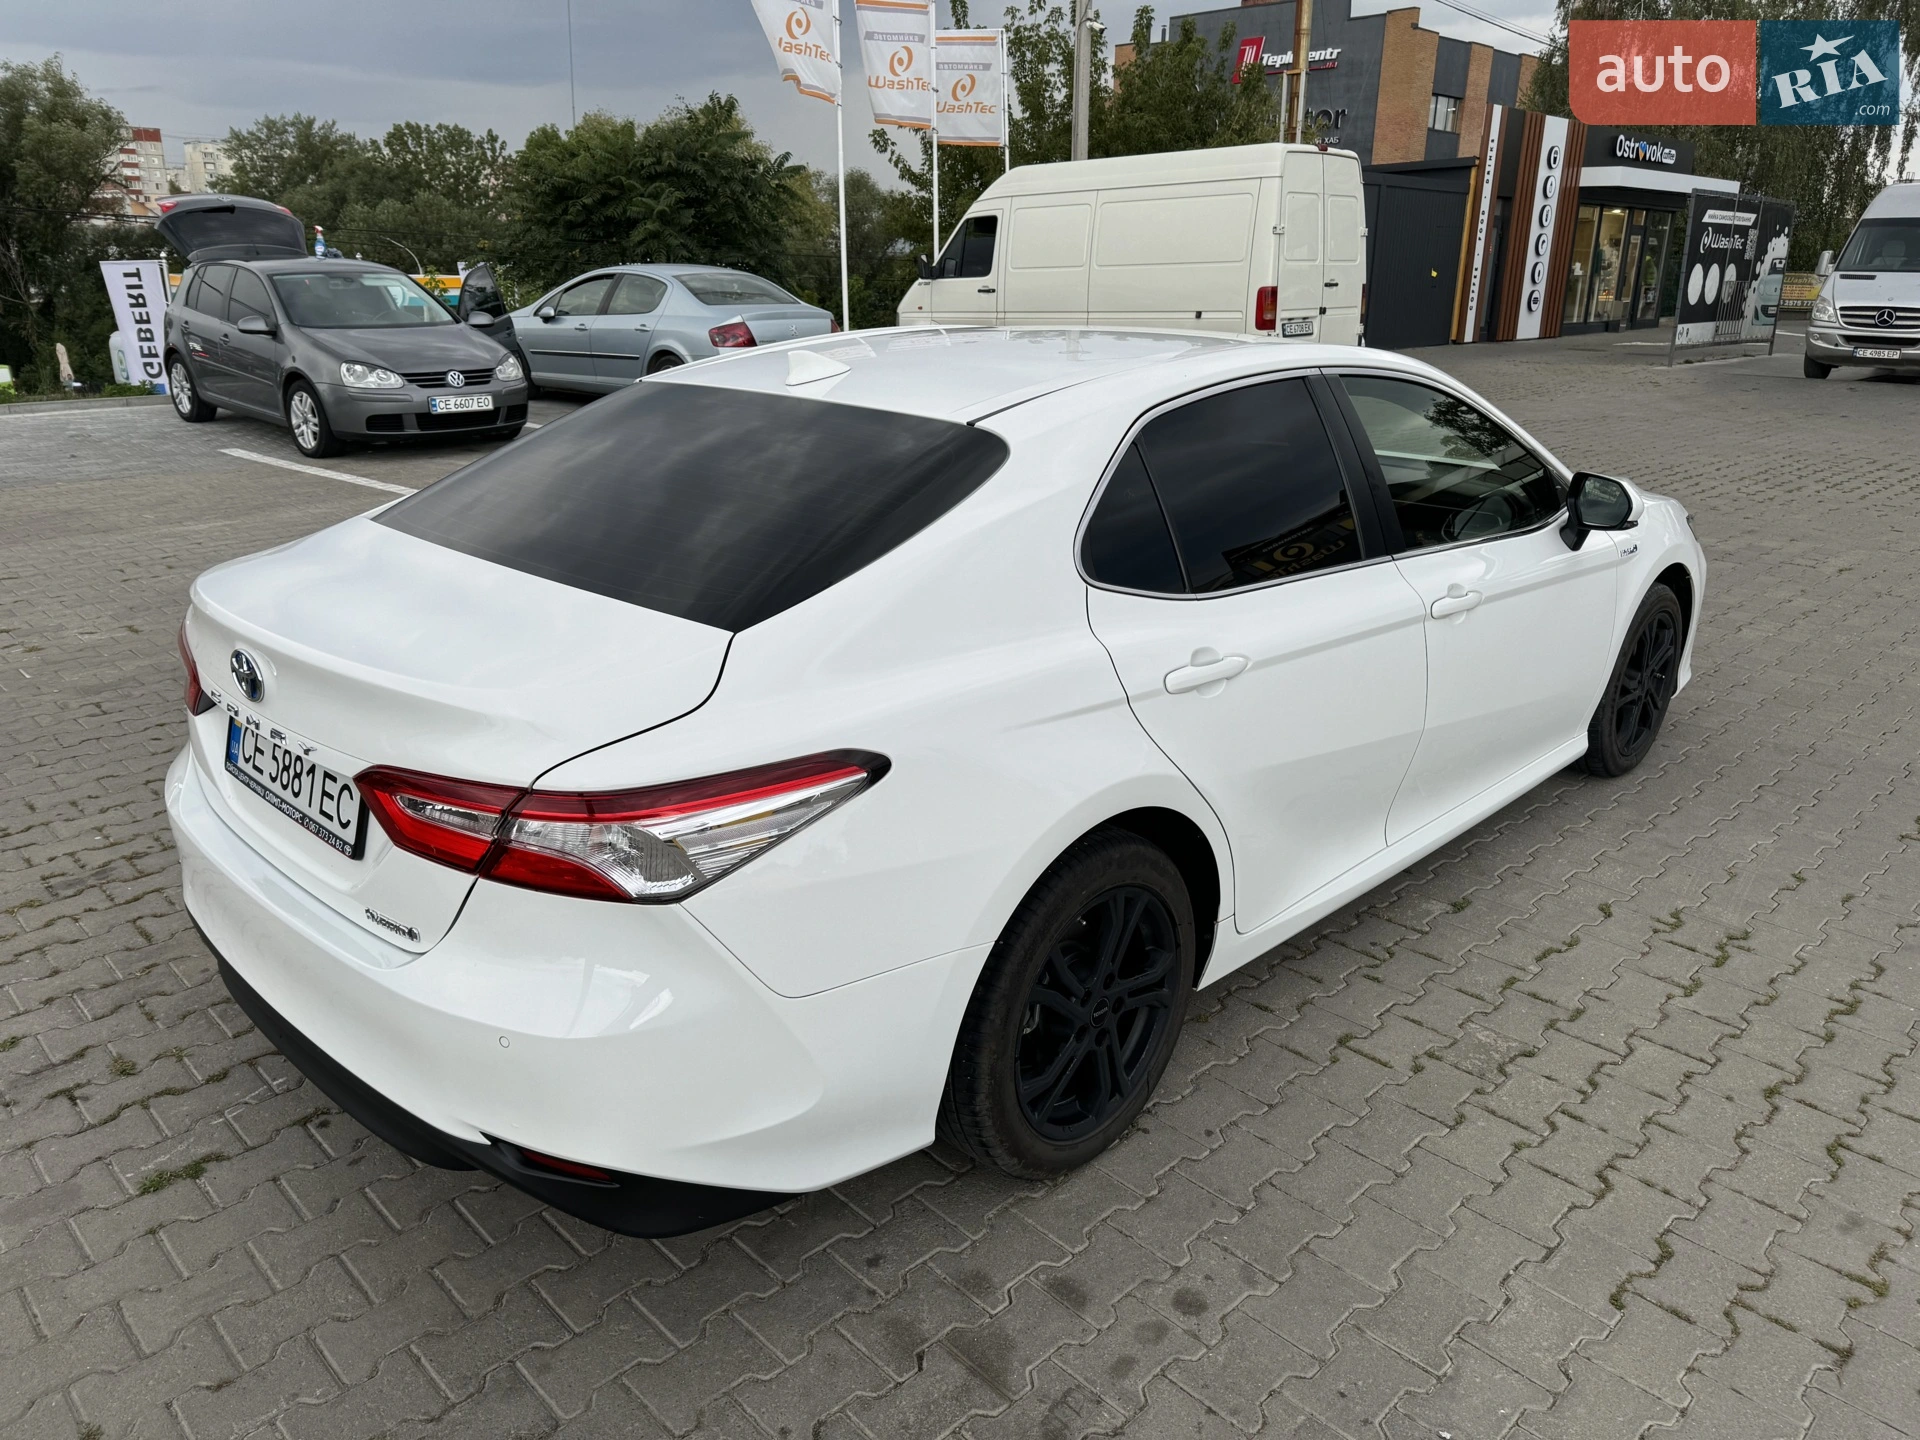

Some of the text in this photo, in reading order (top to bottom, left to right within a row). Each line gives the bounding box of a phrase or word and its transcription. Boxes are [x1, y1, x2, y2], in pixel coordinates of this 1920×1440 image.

[873, 33, 919, 42] автомийка
[1886, 350, 1898, 358] EP
[438, 400, 452, 410] CE
[453, 398, 475, 410] 6607
[242, 726, 355, 830] CE 5881 EC
[308, 821, 343, 852] 067 373 24 82
